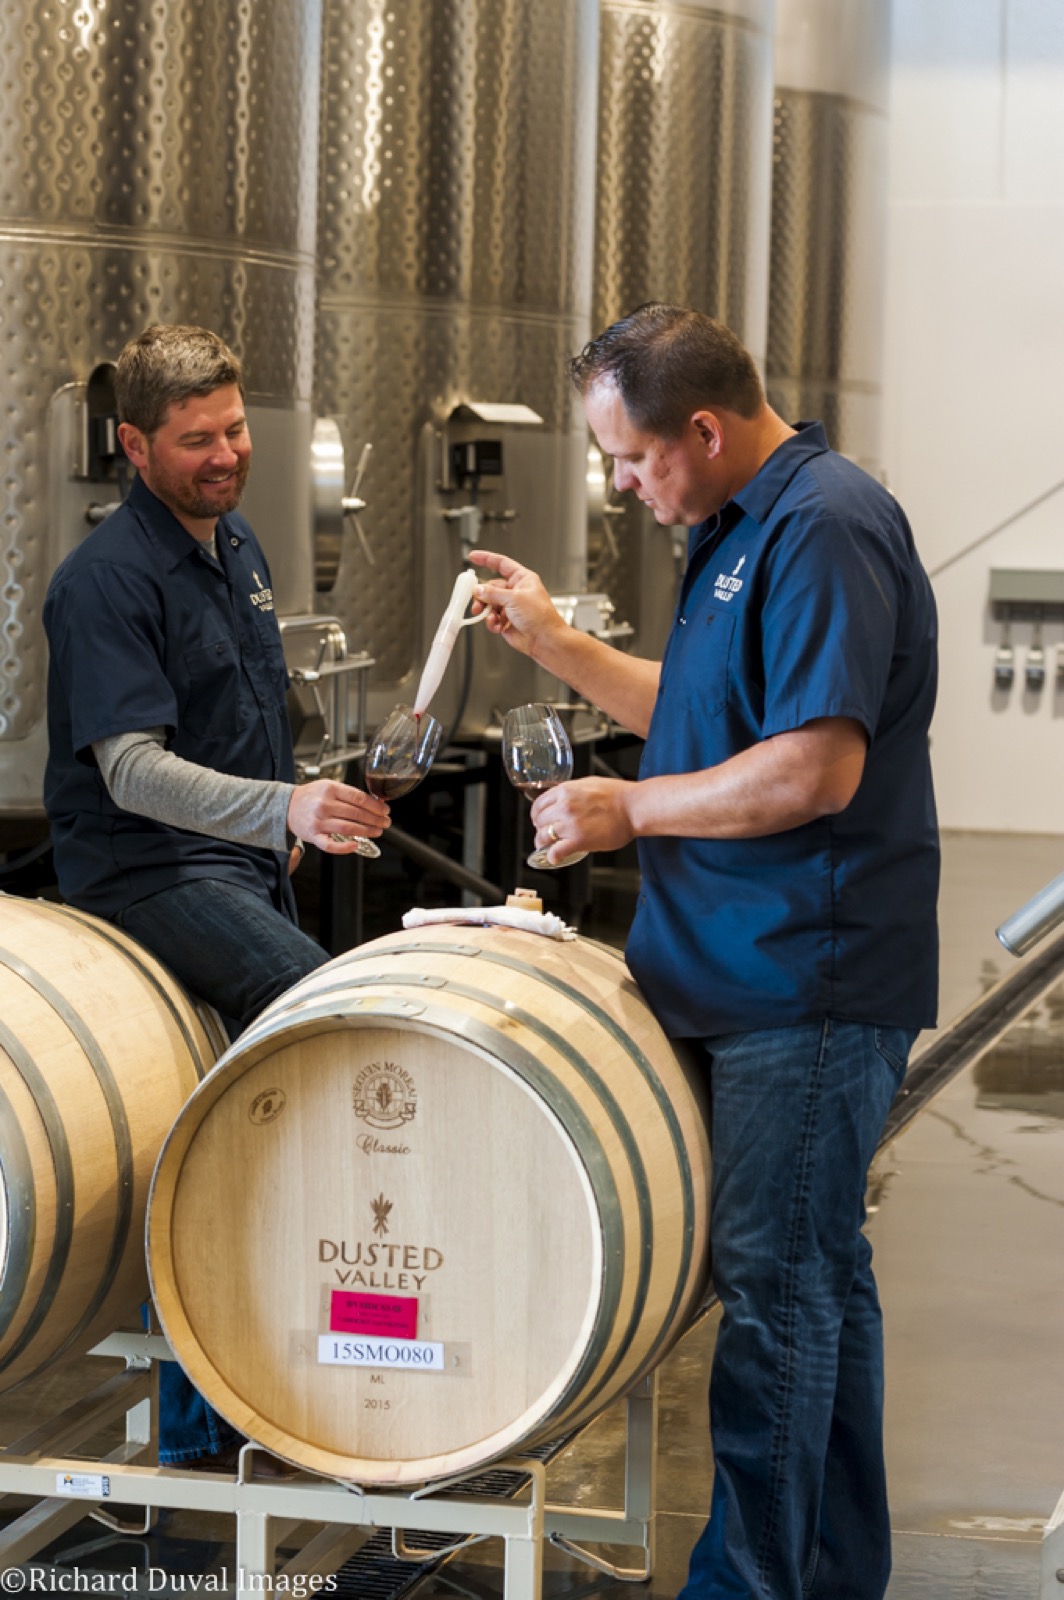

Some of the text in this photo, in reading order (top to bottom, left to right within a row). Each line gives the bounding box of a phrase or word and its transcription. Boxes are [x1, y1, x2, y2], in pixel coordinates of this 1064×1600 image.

[356, 1133, 412, 1156] Classic
[318, 1238, 444, 1271] DUSTED
[335, 1268, 427, 1291] VALLEY
[332, 1341, 434, 1365] 15SMO080
[363, 1397, 391, 1410] 2015
